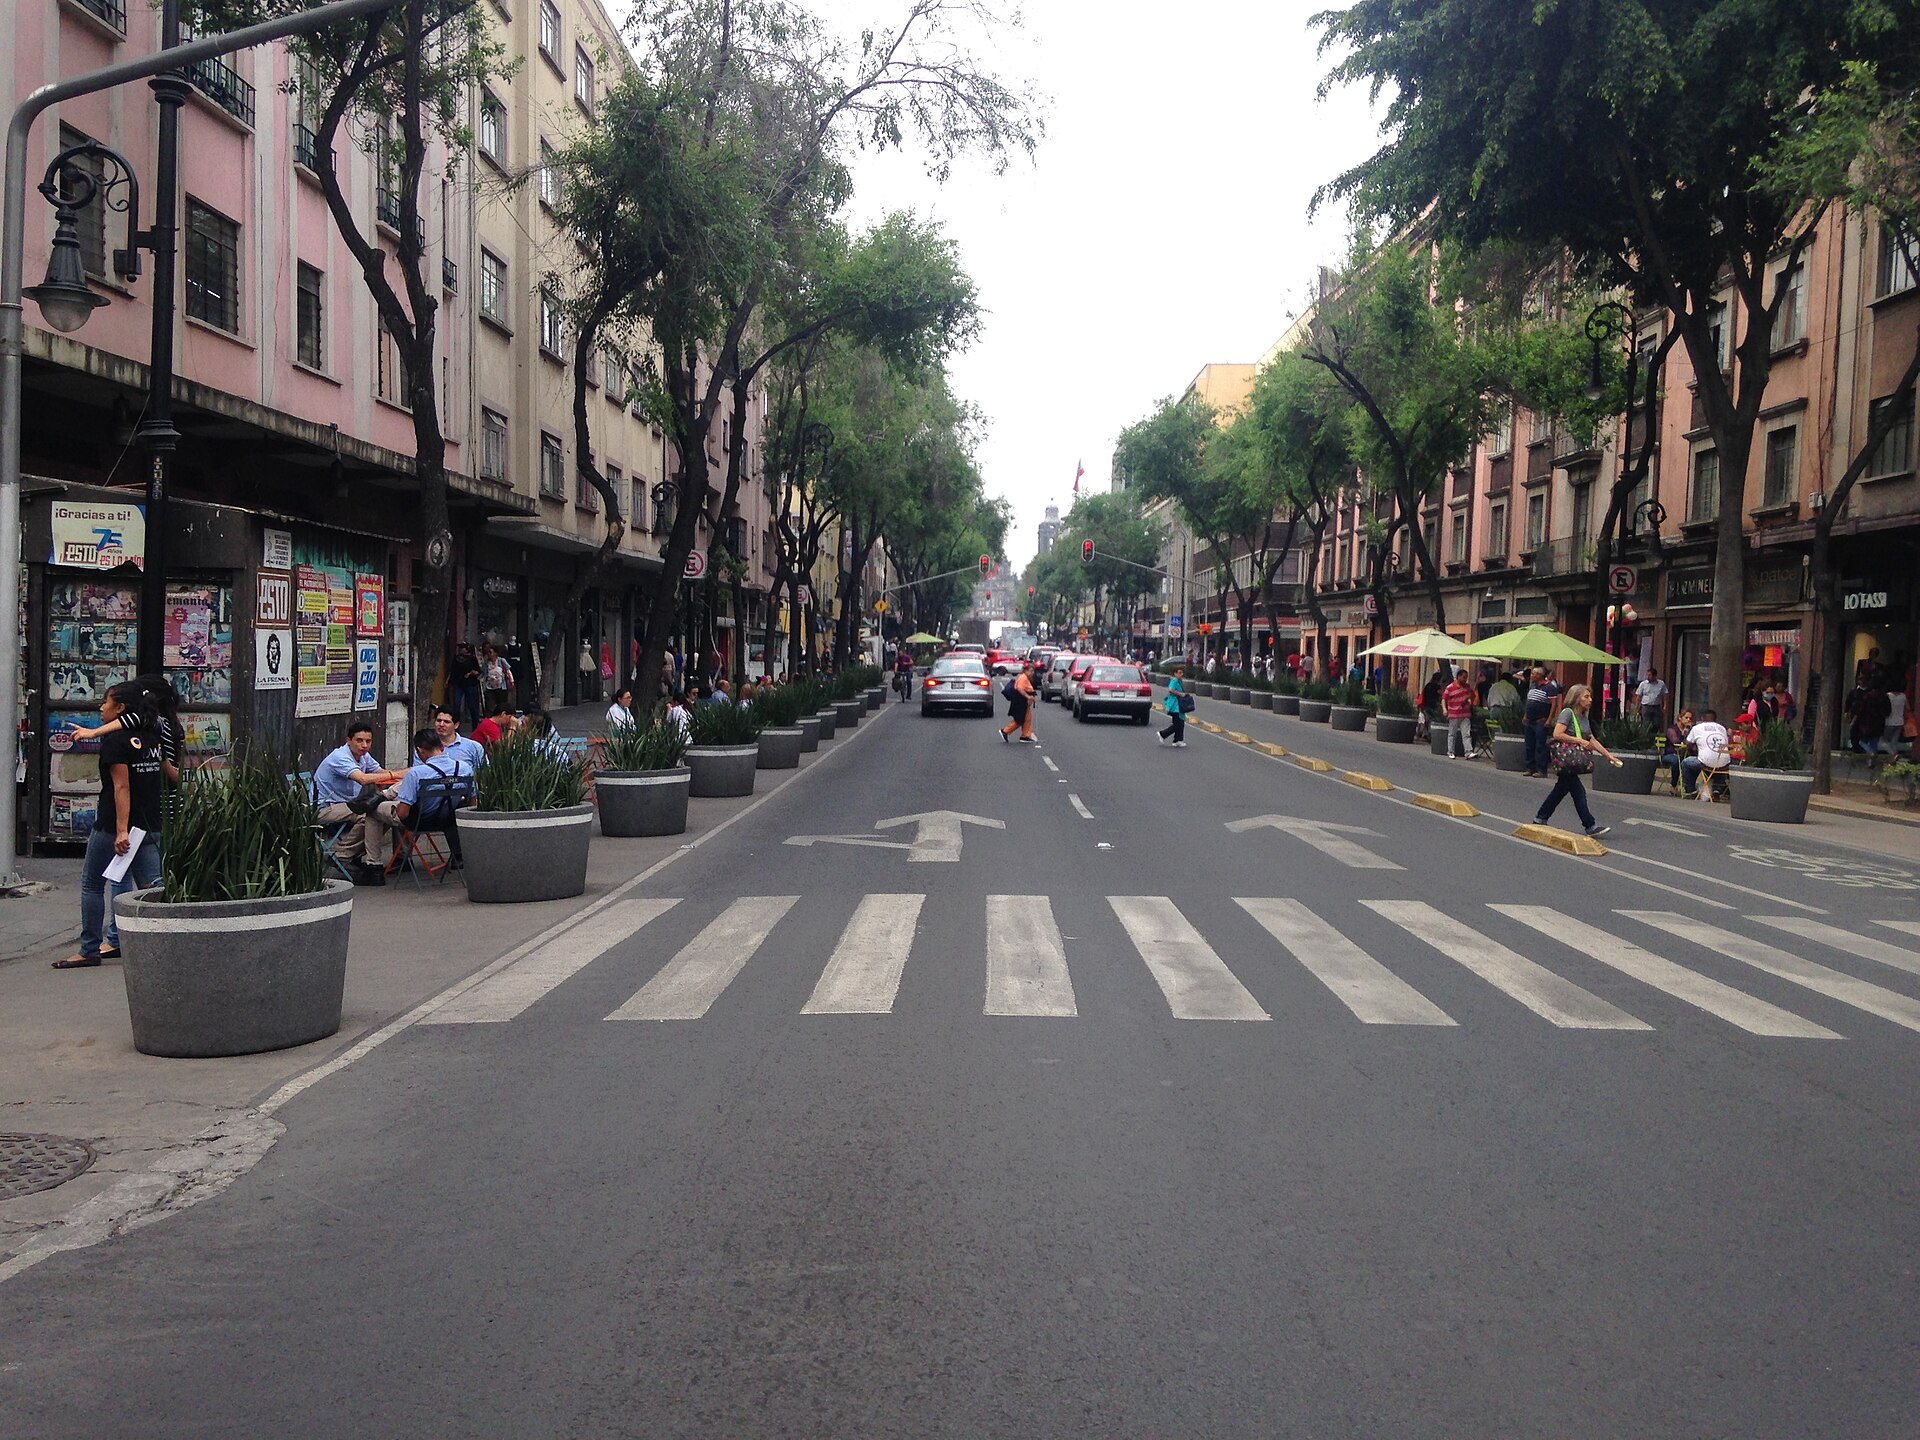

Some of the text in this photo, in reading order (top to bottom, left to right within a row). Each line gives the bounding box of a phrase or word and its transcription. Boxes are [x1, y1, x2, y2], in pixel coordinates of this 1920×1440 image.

[55, 508, 131, 521] ¡Gracias a ti!
[91, 527, 123, 553] 75
